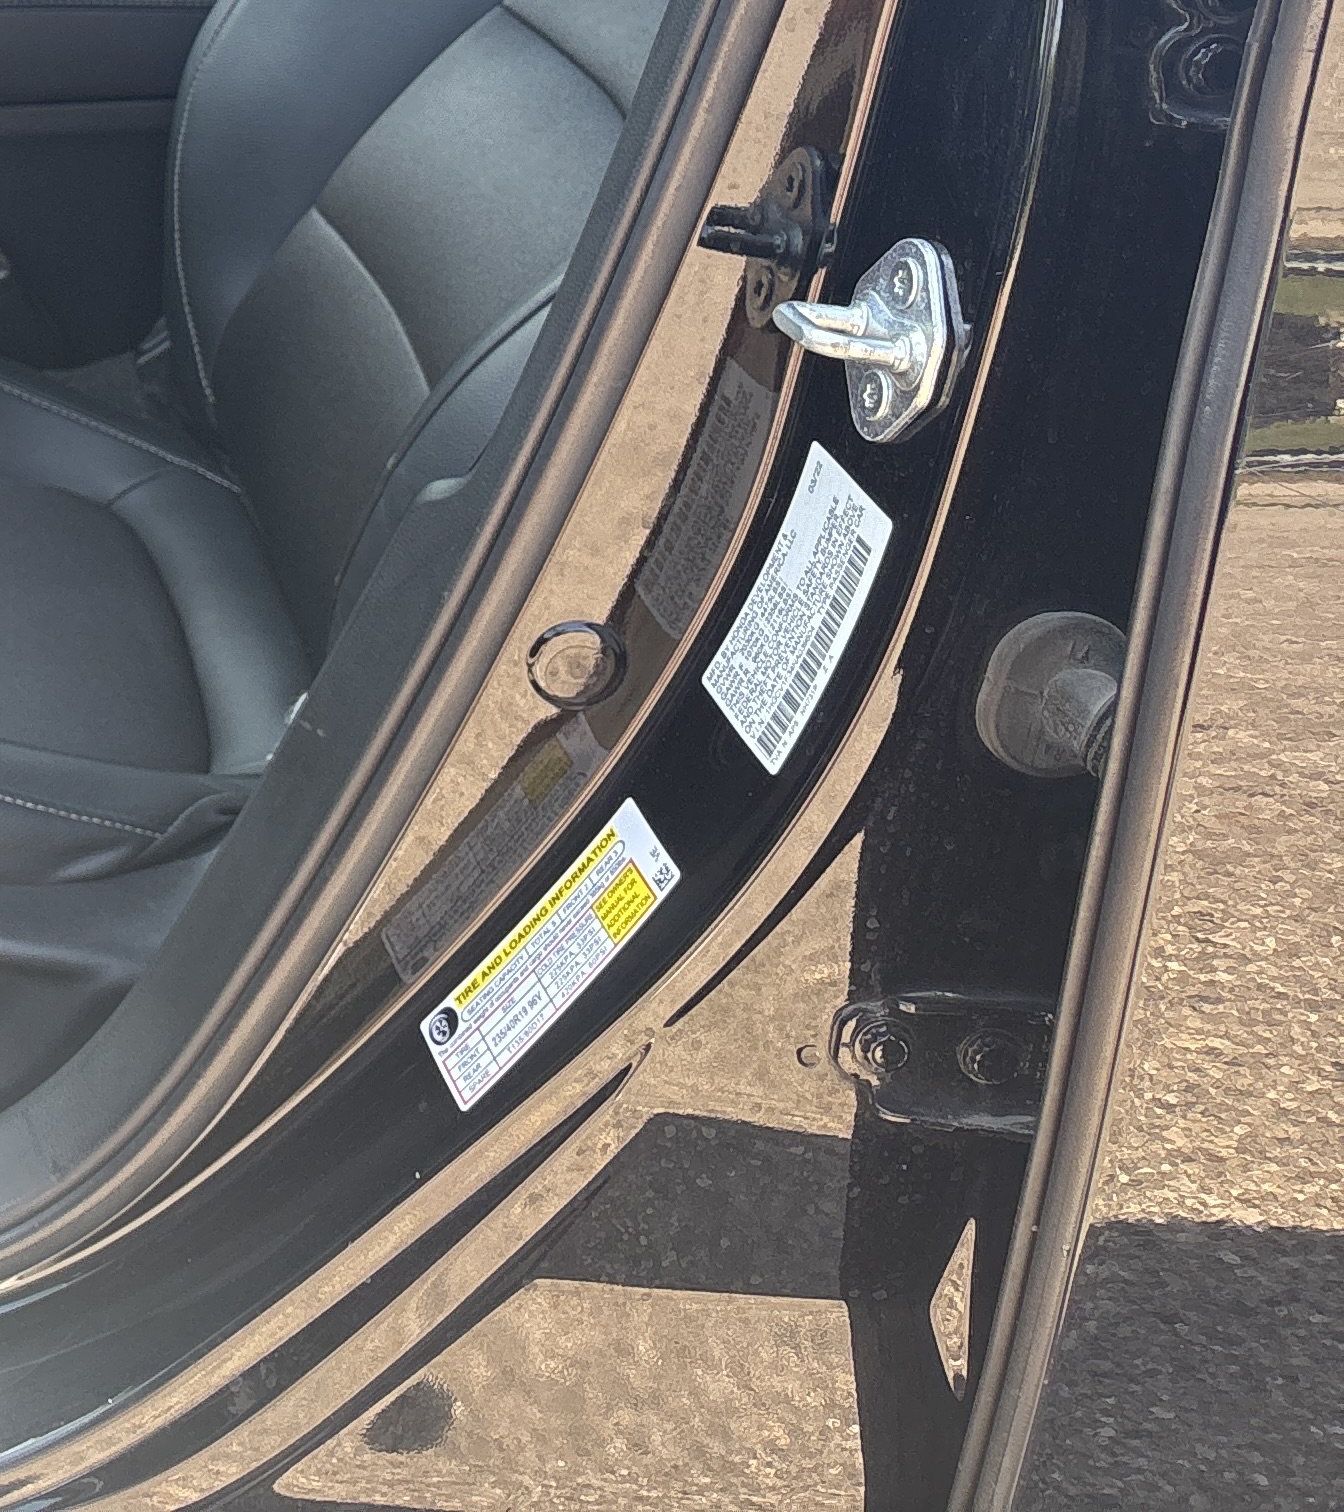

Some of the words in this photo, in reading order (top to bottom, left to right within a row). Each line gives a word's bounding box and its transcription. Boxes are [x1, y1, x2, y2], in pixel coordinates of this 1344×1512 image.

[808, 460, 822, 494] 03/22
[817, 591, 830, 615] TYPE
[829, 528, 856, 589] PASSENGER
[854, 504, 865, 528] CAR
[711, 609, 757, 688] MANUFACTURING
[756, 595, 765, 609] OF
[786, 529, 797, 550] LLC
[720, 645, 729, 658] BY
[728, 610, 748, 645] HONDA
[747, 540, 784, 610] DEVELOPMENT
[730, 690, 744, 712] THIS
[744, 649, 768, 689] VEHICLE
[767, 592, 798, 649] CONFORMS
[797, 576, 806, 591] TO
[804, 559, 814, 577] ALL
[811, 495, 839, 558] APPLICABLE
[734, 677, 761, 720] FEDERAL
[760, 639, 782, 676] MOTOR
[781, 597, 804, 639] VEHICLE
[802, 557, 822, 597] SAFETY
[820, 513, 839, 556] BUMPER
[739, 705, 754, 728] AND
[753, 674, 772, 705] THEFT
[771, 610, 806, 674] PREVENTION
[804, 549, 833, 610] STANDARDS
[831, 536, 839, 549] IN
[835, 494, 854, 536] EFFECT
[744, 716, 756, 734] ON
[755, 697, 767, 716] THE
[766, 671, 783, 698] DATE
[782, 655, 792, 671] OF
[790, 580, 827, 655] MANUFACTURE
[825, 538, 845, 579] SHOWN
[842, 503, 858, 540] ABOVE
[595, 855, 613, 876] REAR
[456, 978, 479, 1005] TIRE
[478, 954, 502, 982] AND
[502, 905, 548, 958] LOADING
[547, 827, 616, 908] INFORMATION
[562, 889, 583, 914] FRONT
[594, 896, 606, 912] SEE
[600, 893, 624, 921] MANUAL
[624, 877, 637, 895] FOR
[606, 891, 639, 930] ADDITIONAL
[612, 893, 651, 939] INFORMATION
[531, 925, 550, 948] TOTAL
[537, 956, 553, 975] COLD
[552, 944, 564, 958] TIRE
[565, 912, 593, 945] PRESSURE
[467, 986, 493, 1016] SEATING
[494, 953, 524, 987] CAPACITY
[501, 996, 516, 1013] SIZE
[492, 1007, 527, 1047] 235/40R19
[456, 1043, 469, 1058] TIRE
[458, 1046, 480, 1072] FRONT
[463, 1062, 481, 1083] REAR
[469, 1069, 490, 1093] SPARE
